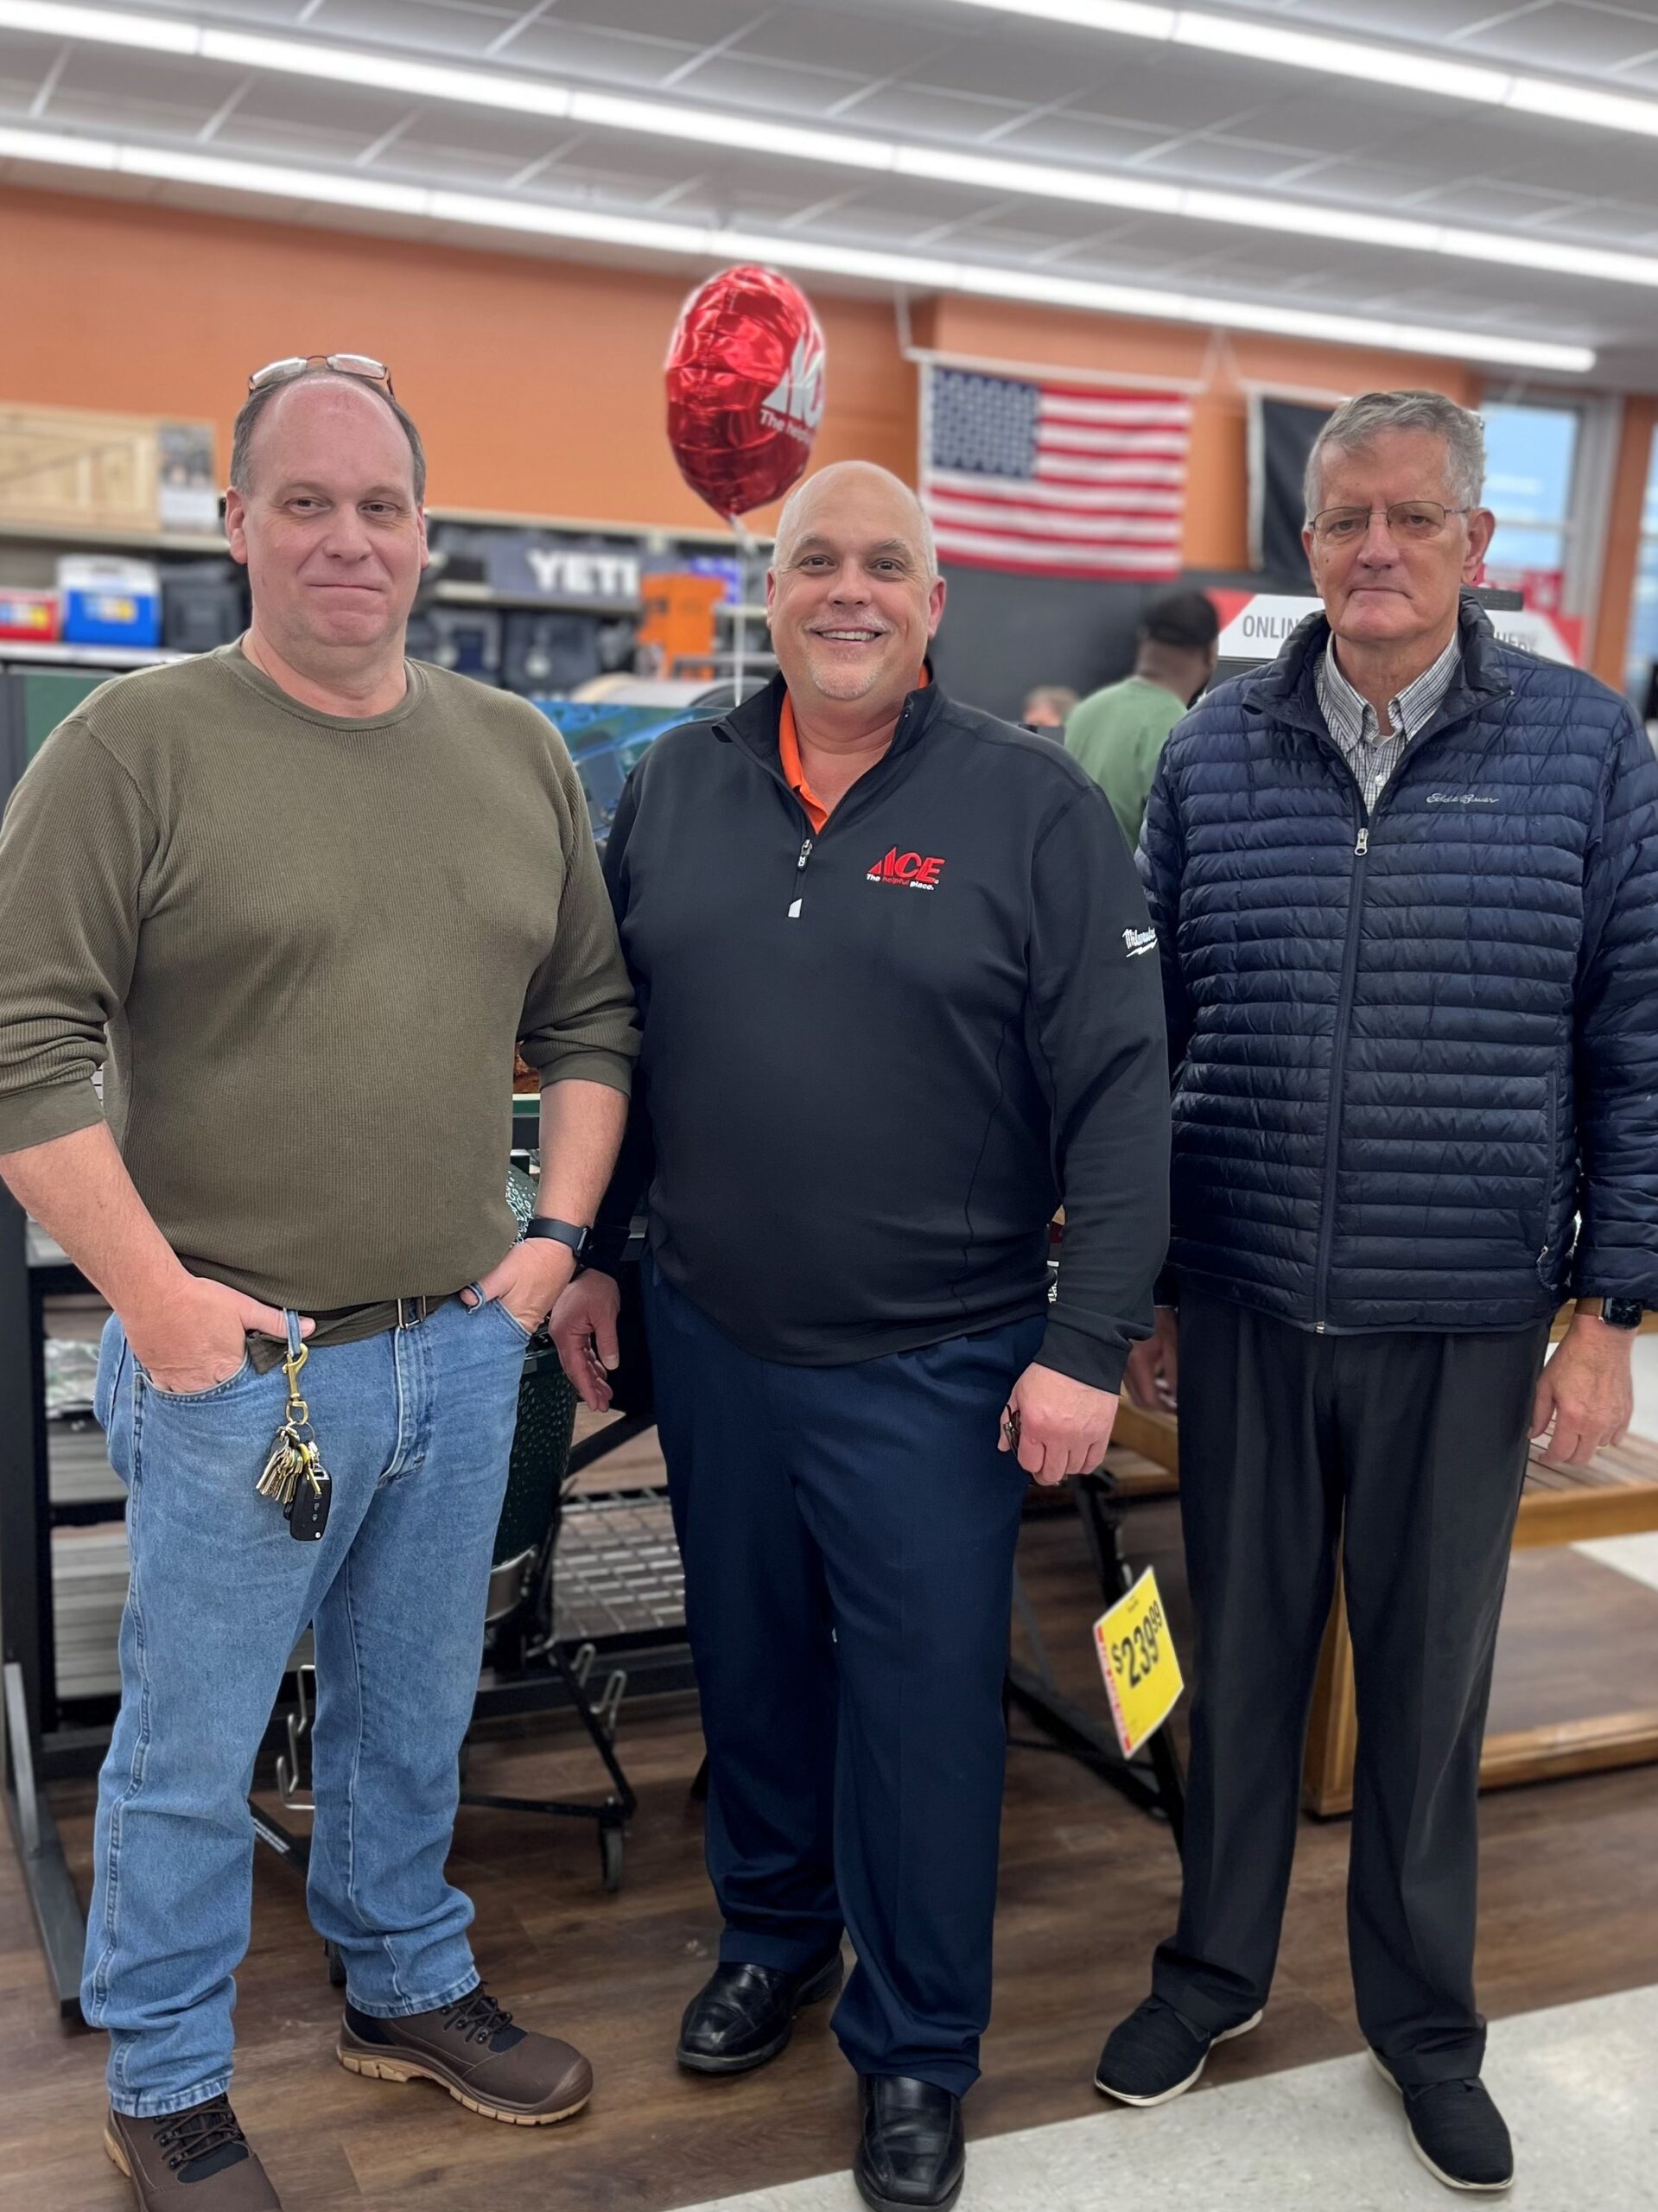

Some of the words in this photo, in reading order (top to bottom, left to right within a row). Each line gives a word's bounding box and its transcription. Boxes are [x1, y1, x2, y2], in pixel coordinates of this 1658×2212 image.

[525, 550, 638, 596] YETI
[1242, 614, 1299, 639] ONLIN
[867, 874, 880, 882] The
[868, 846, 945, 885] ACE
